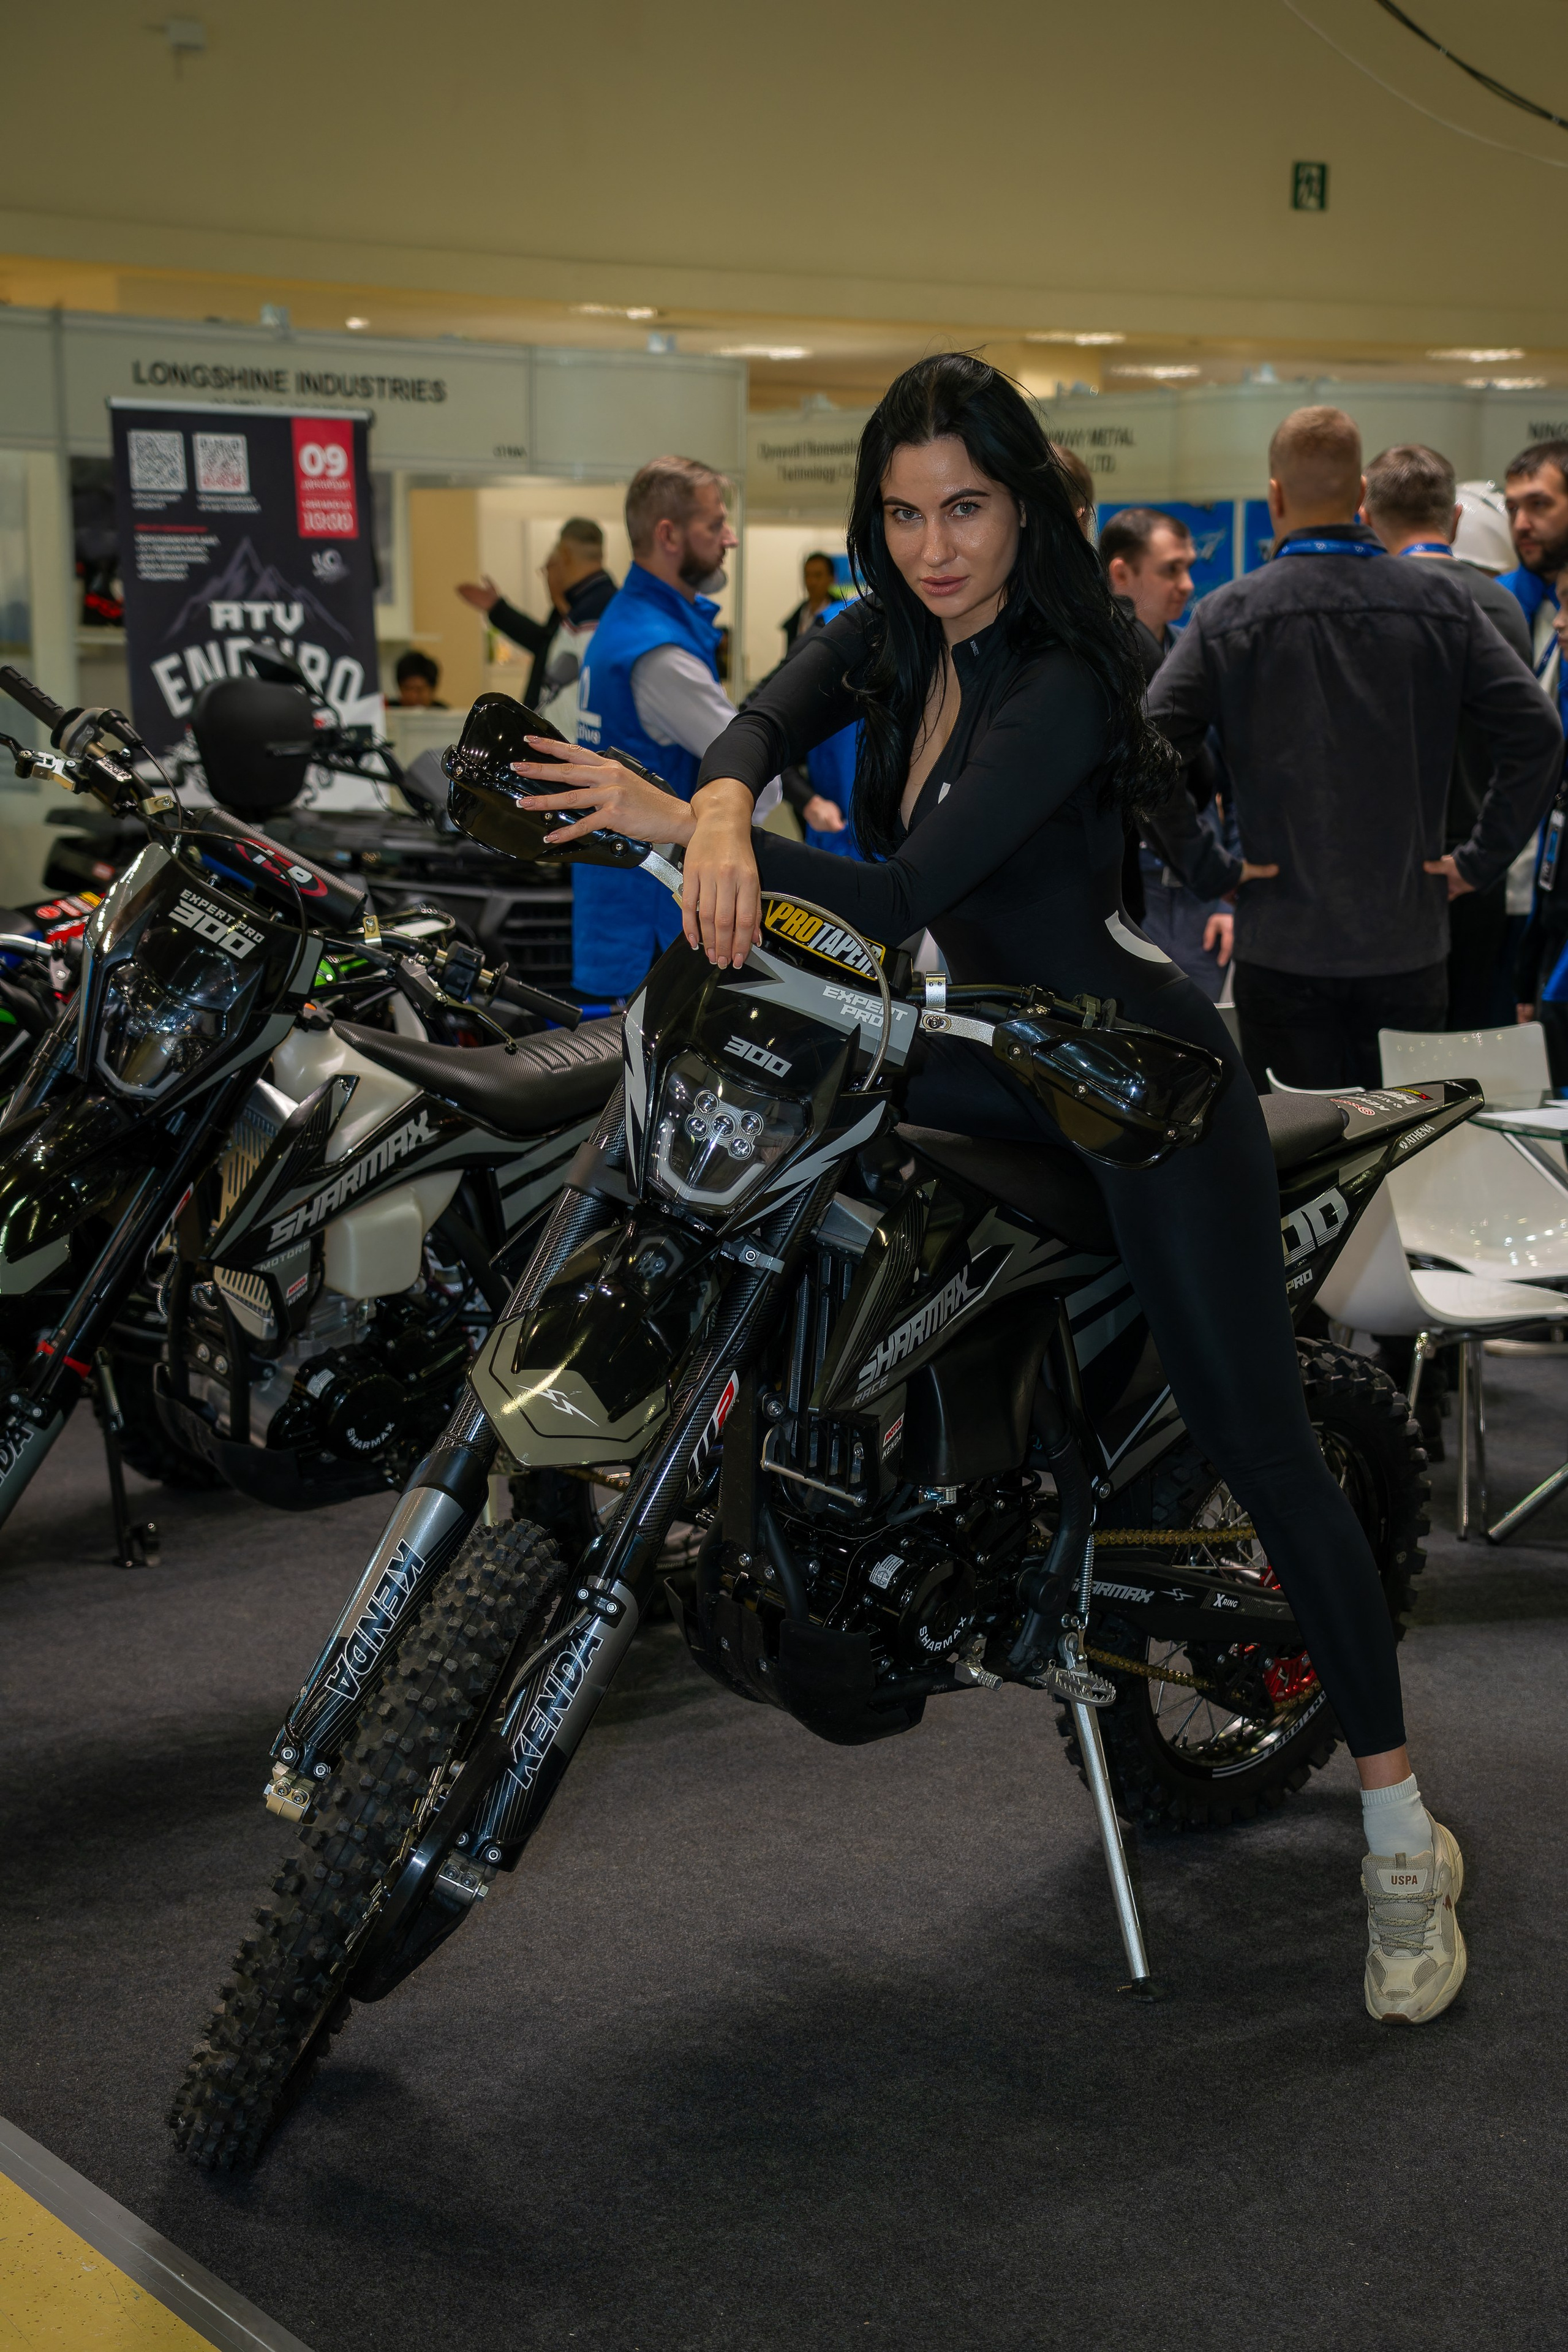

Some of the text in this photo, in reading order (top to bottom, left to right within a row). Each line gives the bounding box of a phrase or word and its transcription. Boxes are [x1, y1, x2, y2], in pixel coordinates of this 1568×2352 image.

[132, 360, 447, 404] LONGSHINE INDUSTRIES
[298, 442, 348, 477] 09
[209, 600, 305, 635] ATV
[168, 898, 256, 959] 300
[180, 888, 265, 944] EXPERT PRO
[840, 1003, 884, 1028] PRO
[723, 1035, 793, 1078] 300
[1404, 1123, 1436, 1147] ATHENA
[266, 1109, 440, 1252] SHARMAX
[1286, 1268, 1313, 1294] PRO
[856, 1264, 982, 1393] SHARMAX
[851, 1374, 889, 1407] RACE
[346, 1422, 395, 1450] SHARMAX
[882, 1432, 902, 1460] KENDA
[324, 1538, 426, 1701] KENDA
[919, 1616, 967, 1651] SHARMAX
[507, 1625, 604, 1790] KENDA
[1390, 1874, 1418, 1885] USPA
